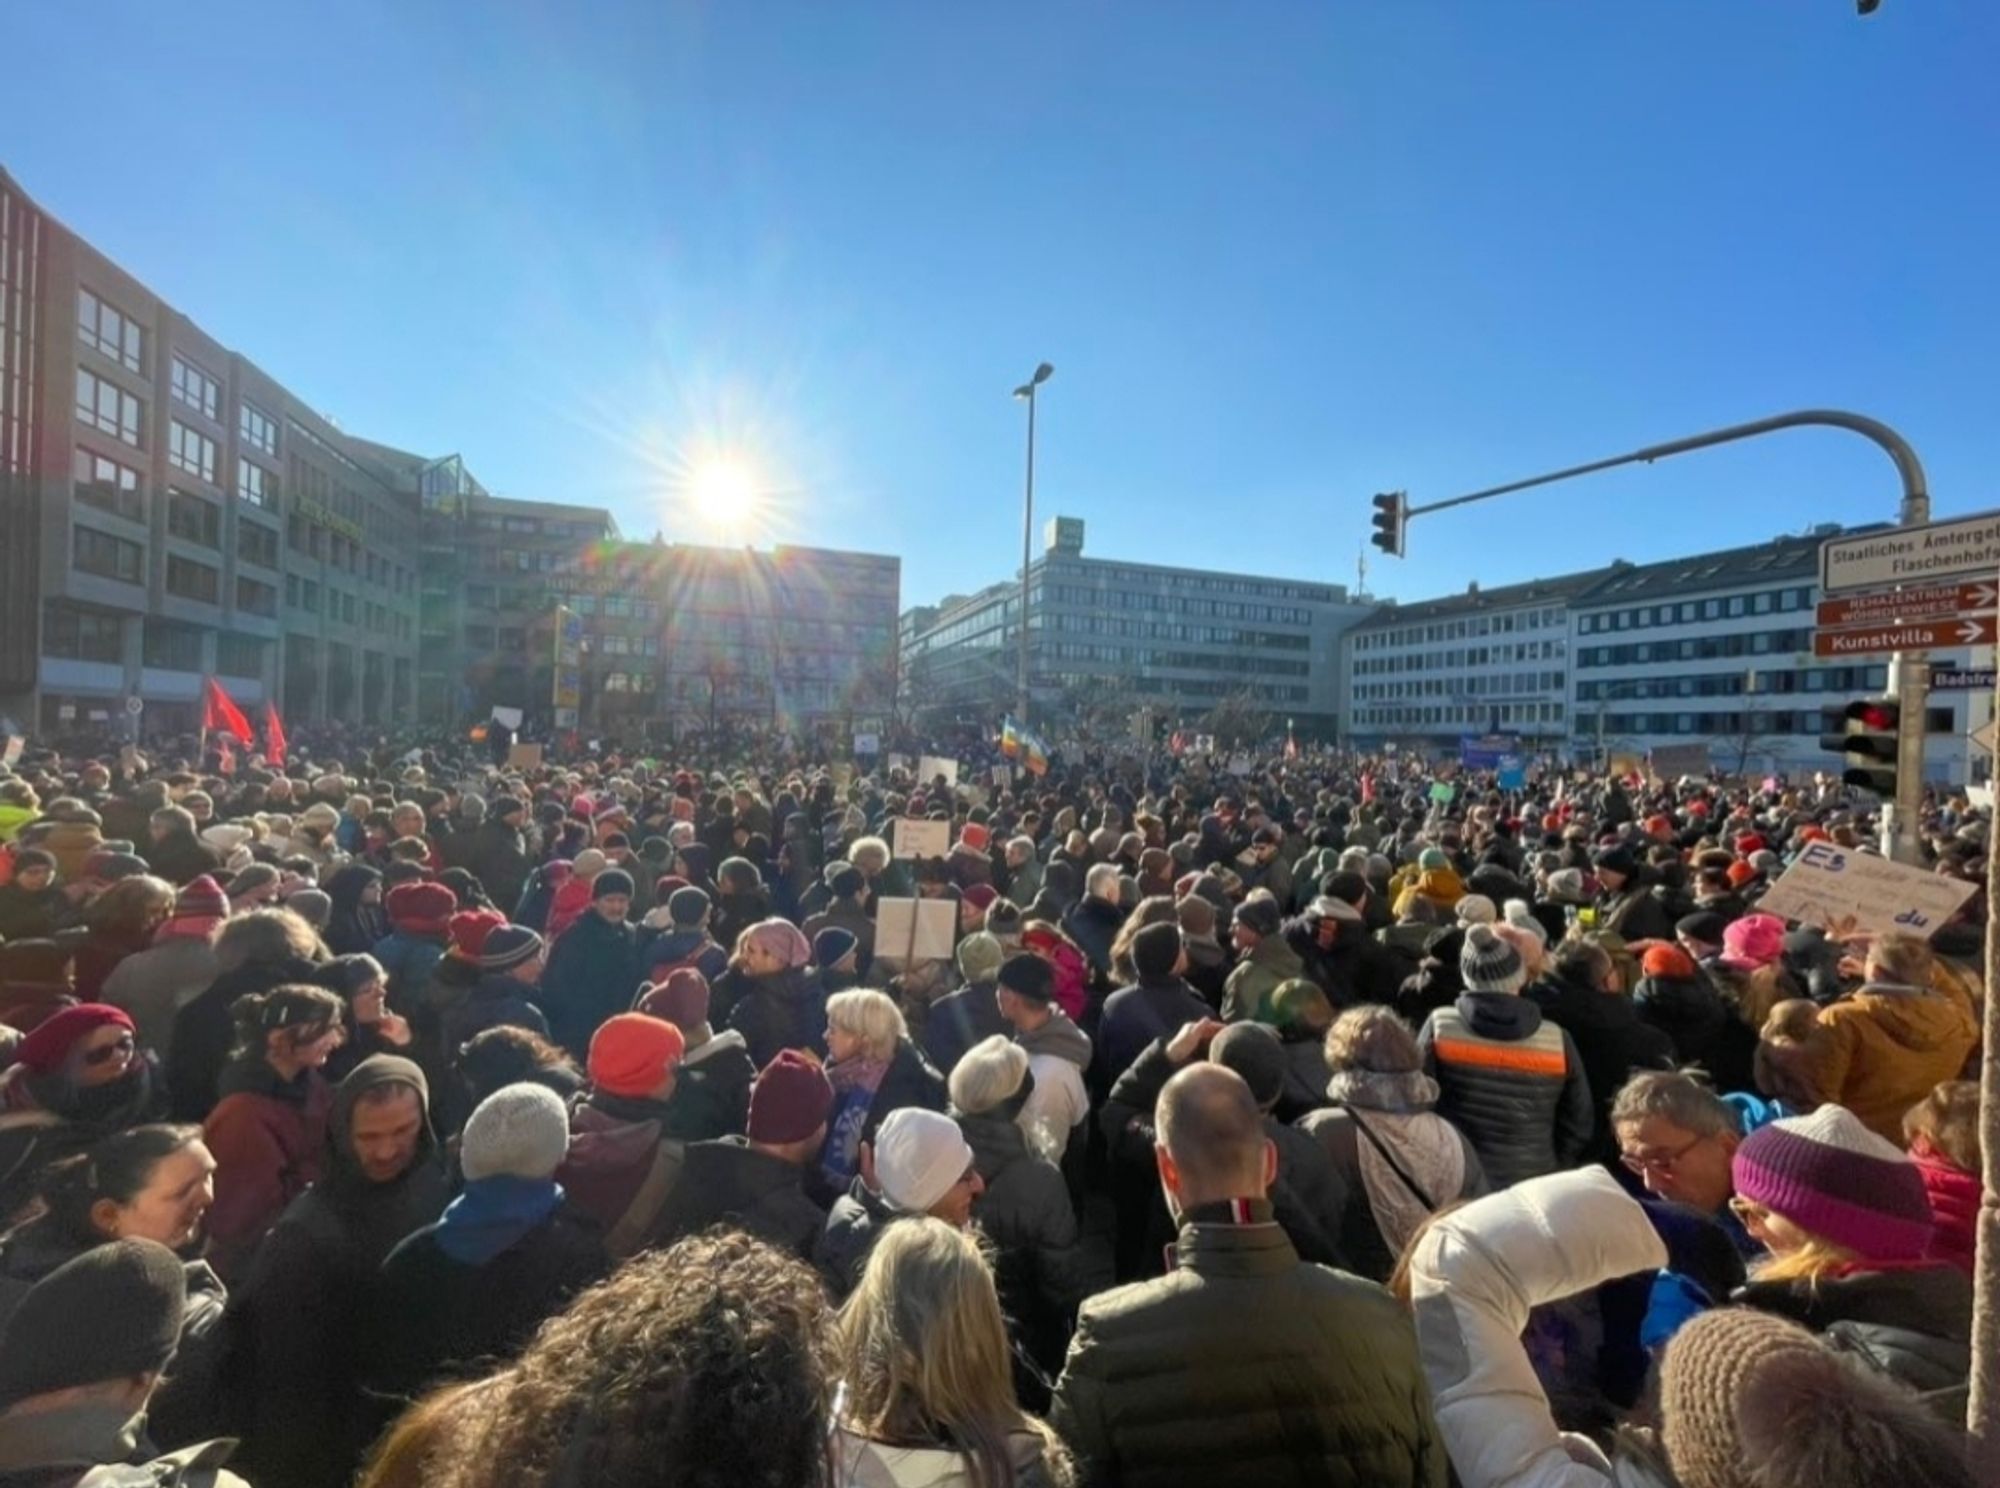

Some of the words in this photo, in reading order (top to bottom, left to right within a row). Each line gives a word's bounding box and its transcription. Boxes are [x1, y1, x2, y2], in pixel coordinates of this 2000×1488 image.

[1833, 541, 1914, 563] Staatliches
[1832, 629, 1934, 651] Kunstvilla
[1802, 844, 1846, 872] Es
[1894, 908, 1929, 928] du
